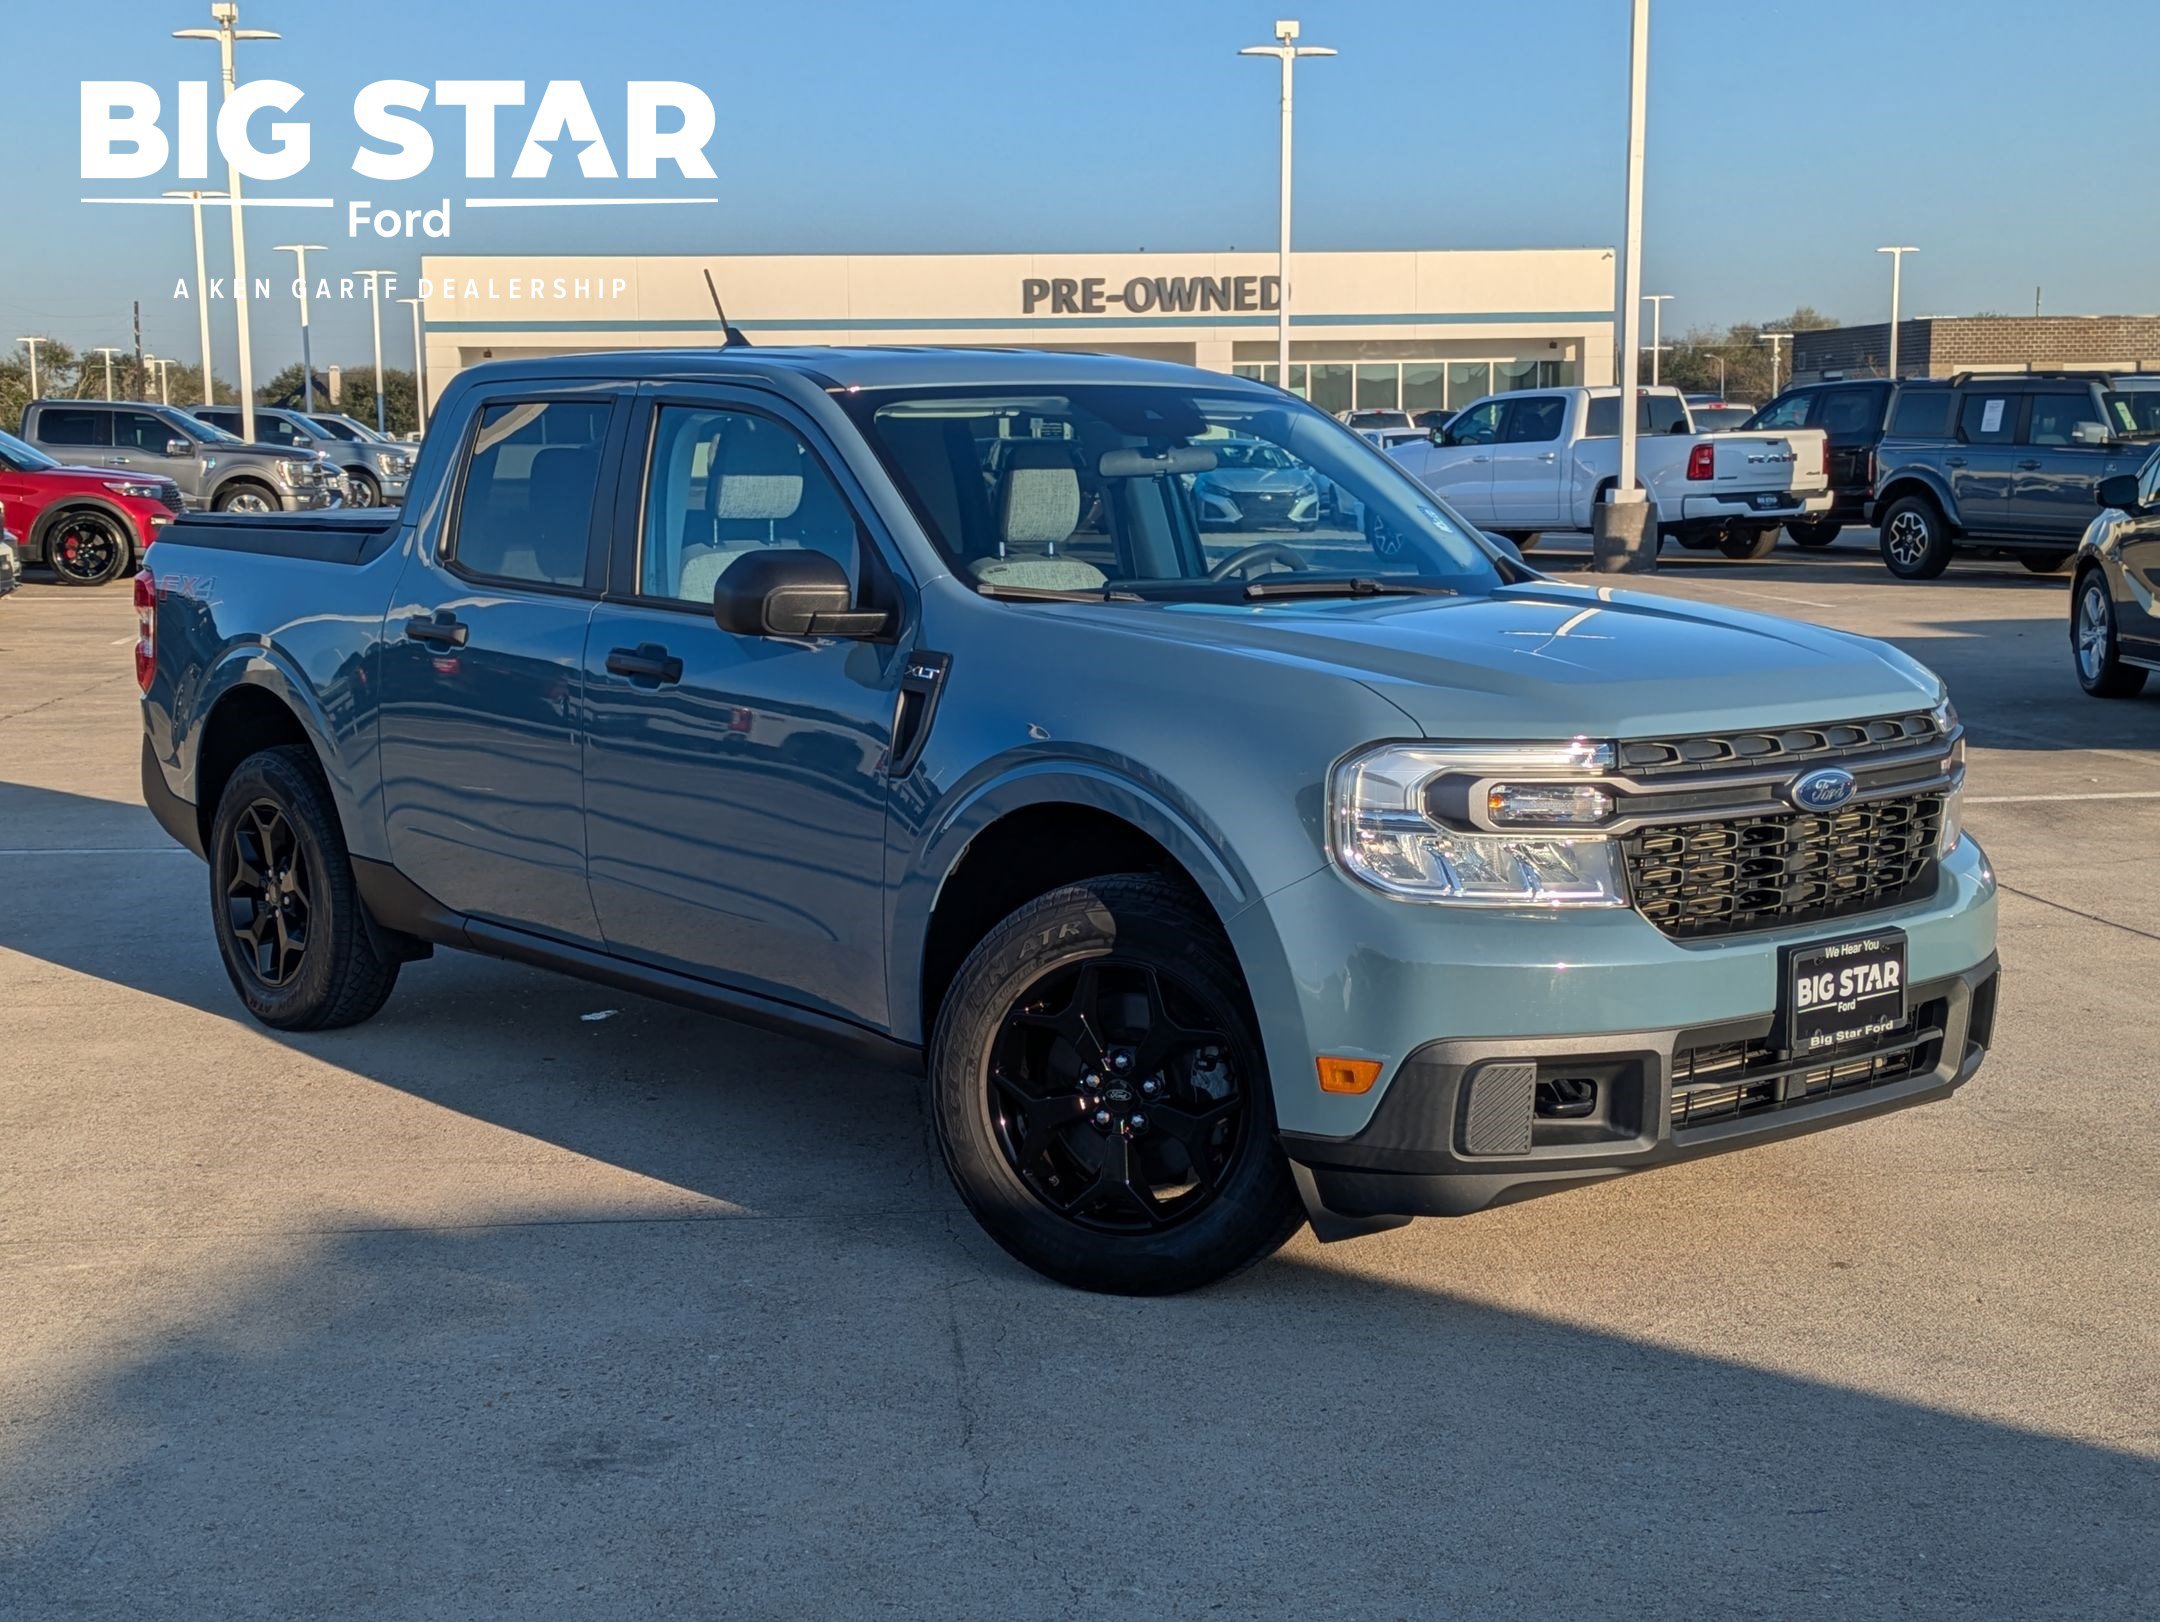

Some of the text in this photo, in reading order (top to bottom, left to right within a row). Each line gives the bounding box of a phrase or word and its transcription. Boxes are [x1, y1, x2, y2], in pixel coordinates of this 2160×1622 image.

[1022, 275, 1291, 314] PRE-OWNED
[904, 664, 941, 680] XLT
[1811, 778, 1846, 803] Ford
[1017, 921, 1082, 961] ATR
[1825, 940, 1880, 959] We Hear You
[1797, 960, 1900, 1008] BIG STAR
[1837, 999, 1856, 1013] Ford
[1810, 1020, 1894, 1048] Big Star Ford
